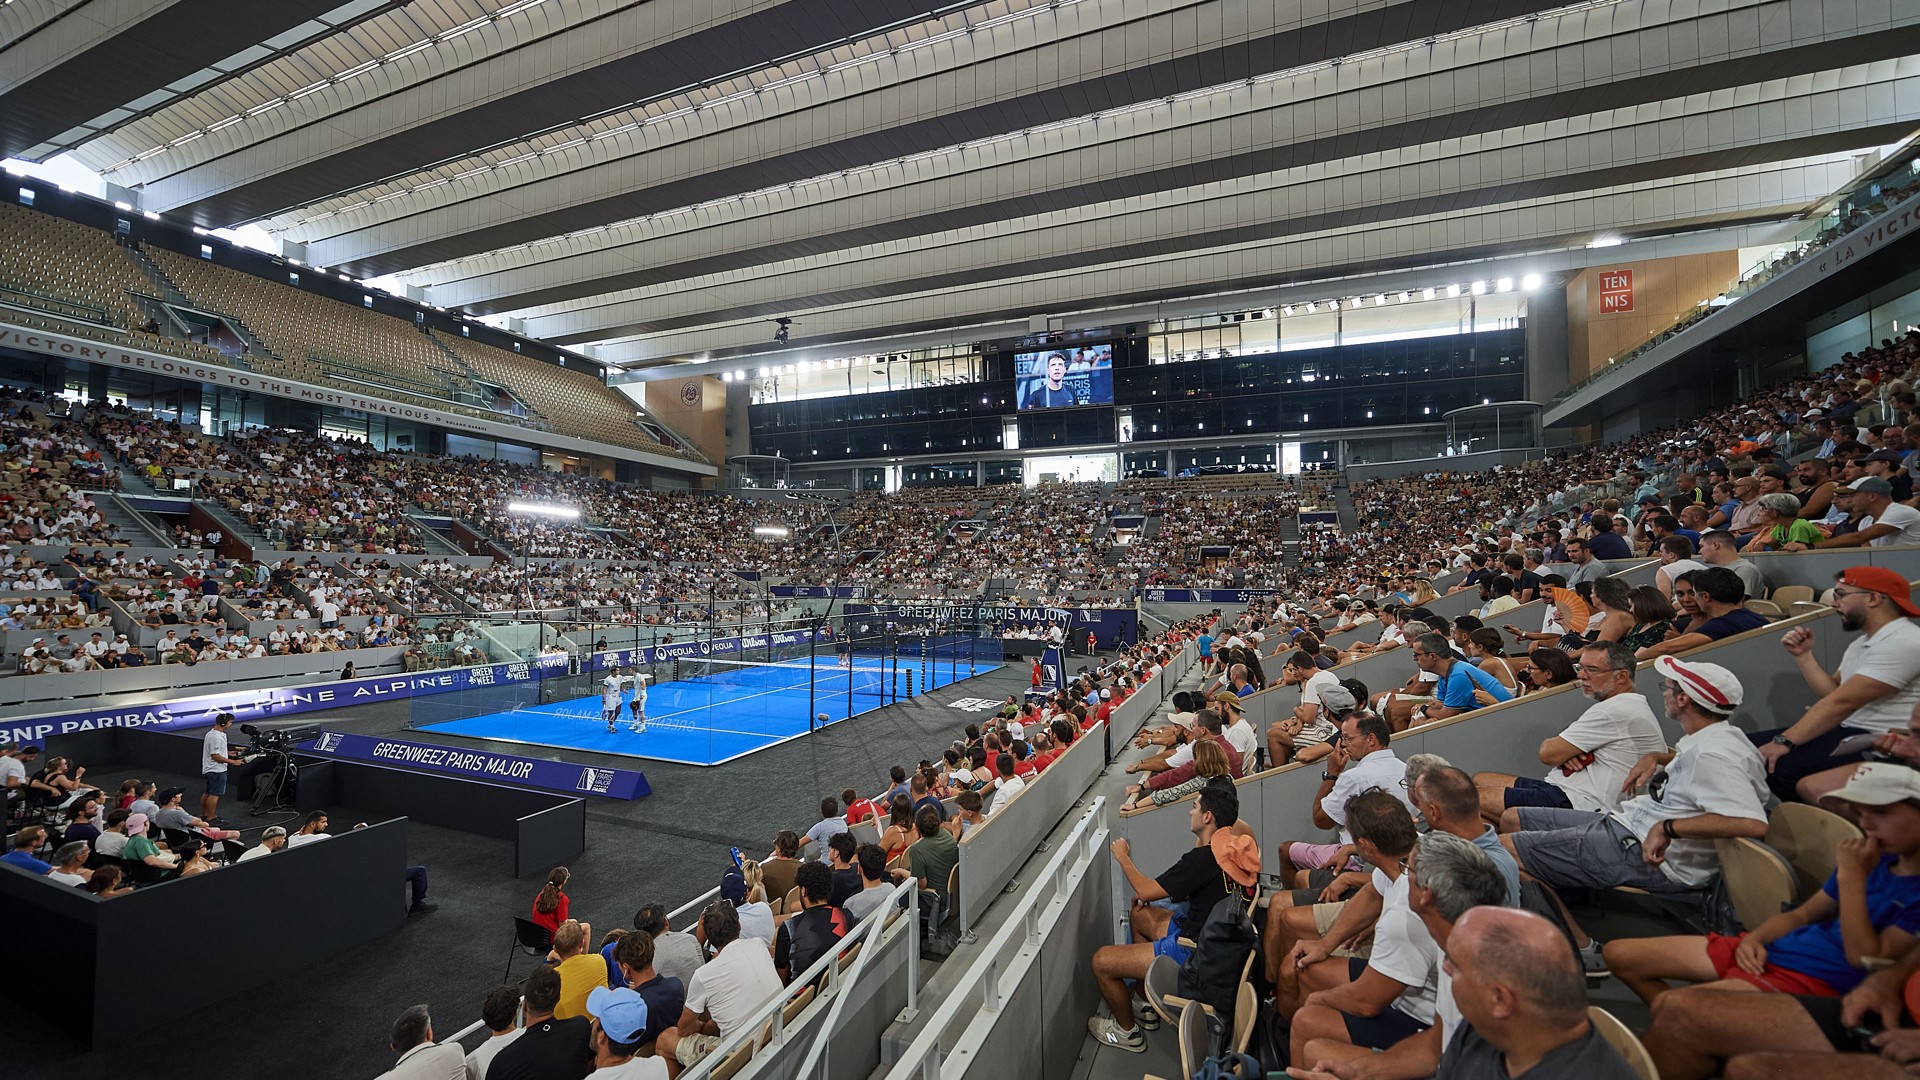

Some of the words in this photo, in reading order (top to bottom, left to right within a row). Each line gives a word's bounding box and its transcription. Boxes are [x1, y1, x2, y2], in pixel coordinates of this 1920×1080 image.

[1836, 246, 1855, 266] LA
[1603, 275, 1628, 289] TEN
[1605, 294, 1628, 308] NIS
[121, 354, 217, 380] BELONGS
[228, 374, 250, 386] TO
[260, 381, 291, 395] THE
[301, 389, 343, 404] MOST
[350, 399, 430, 420] TENACIOUS
[898, 606, 974, 619] GREENWEEZ
[978, 608, 1016, 620] PARIS
[1020, 608, 1066, 621] MAJOR
[741, 637, 768, 649] Wilson
[772, 634, 796, 645] Wilson
[427, 643, 449, 652] GREEN
[667, 646, 694, 657] VEOLIA
[711, 641, 734, 651] VEOLIA
[471, 667, 494, 678] GREEN
[508, 662, 529, 673] GREEN
[476, 676, 496, 685] WEEZ
[512, 671, 531, 680] WEEZ
[202, 690, 336, 717] ALPINE
[353, 675, 453, 698] ALPINE
[0, 724, 54, 744] BNP
[62, 709, 174, 734] PARIBAS
[372, 742, 448, 765] GREENWEEZ
[445, 752, 485, 771] PARIS
[484, 757, 533, 779] MAJOR
